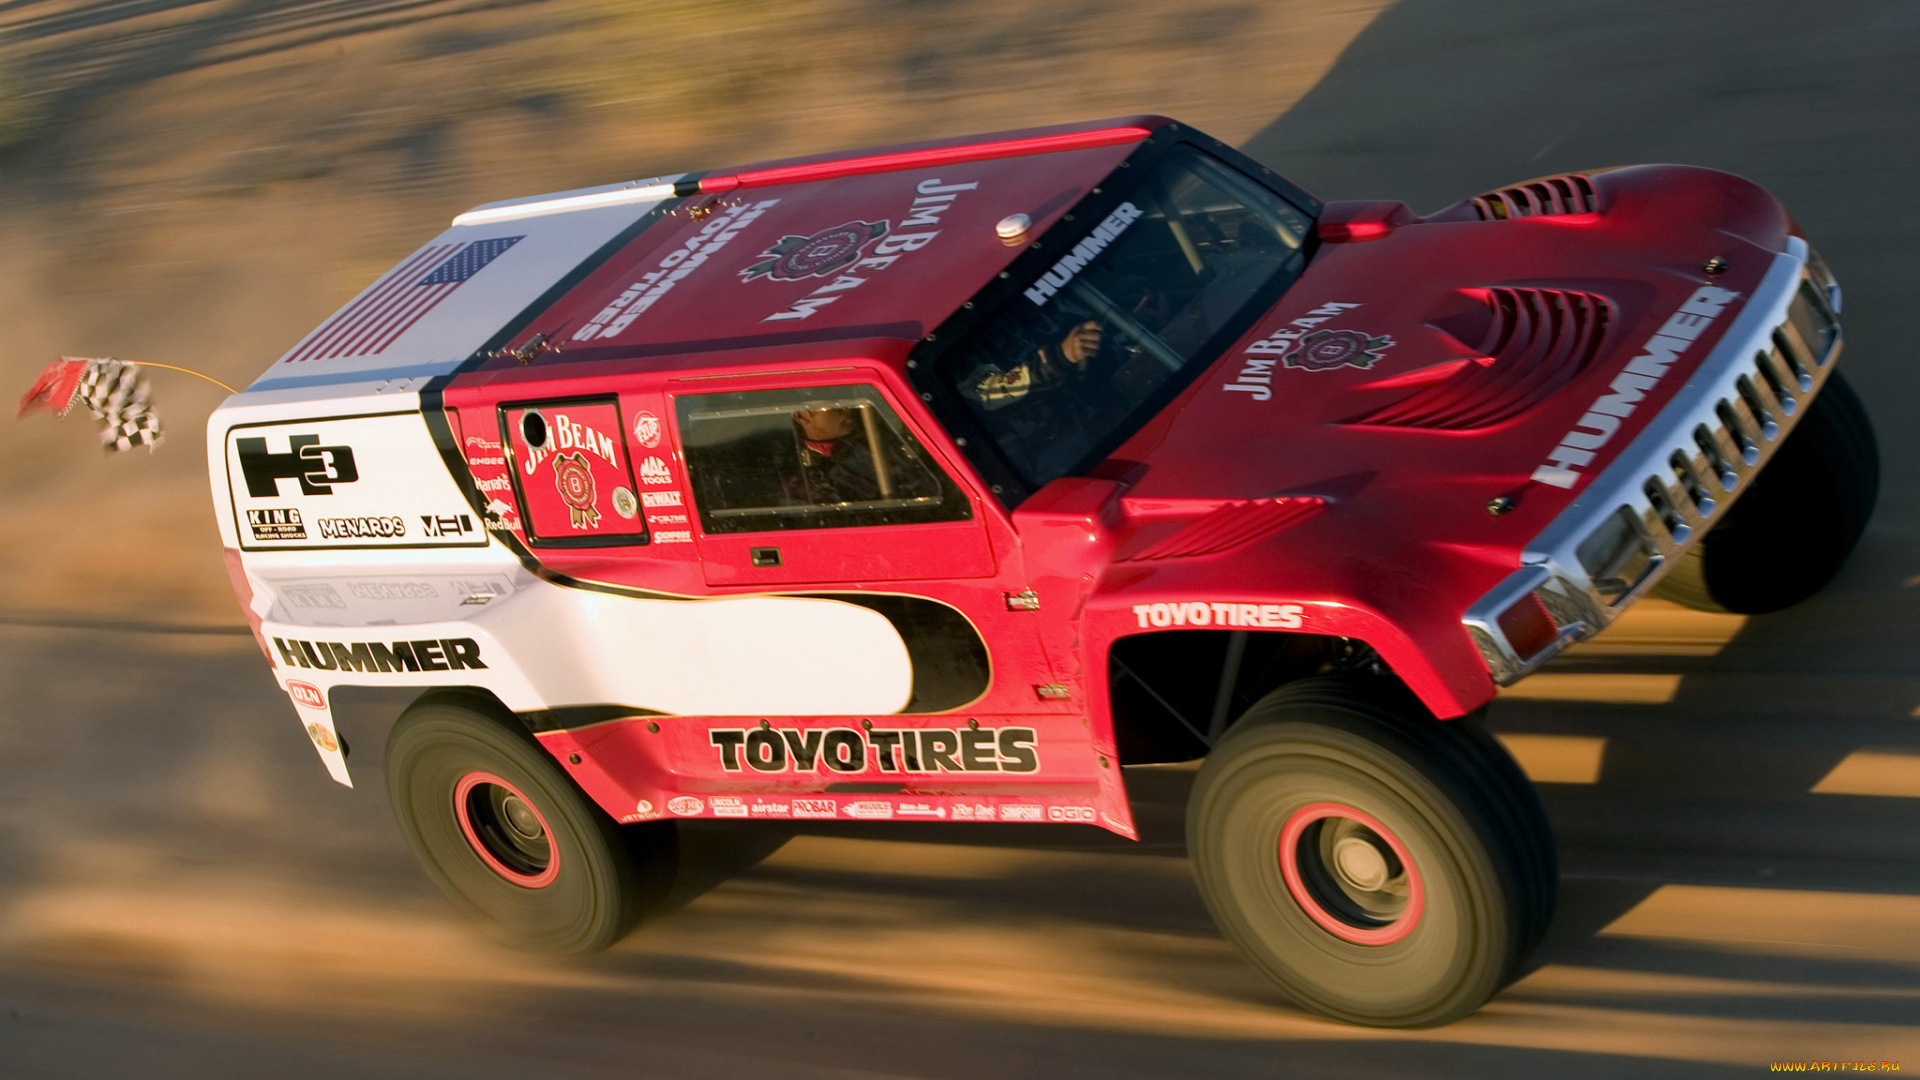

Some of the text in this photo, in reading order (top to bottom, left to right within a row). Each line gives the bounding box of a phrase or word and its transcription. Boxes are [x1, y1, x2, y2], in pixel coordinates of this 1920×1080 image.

[898, 178, 980, 228] JIM
[658, 202, 752, 270] TOYO
[1023, 201, 1144, 307] HUMMER
[594, 199, 781, 341] HUMMER
[760, 228, 943, 324] BEAM
[571, 270, 672, 342] TIRES
[1245, 300, 1366, 356] BEAM
[1222, 358, 1279, 401] JIM
[1530, 285, 1742, 490] HUMMER
[236, 433, 359, 498] H3
[554, 413, 620, 471] BEAM
[640, 455, 671, 477] MAC
[641, 476, 673, 485] TOOLS
[248, 509, 301, 524] KING
[318, 515, 406, 539] MENARDS
[484, 516, 522, 531] Red Bull
[1132, 602, 1303, 628] TOYO TIRES
[272, 636, 489, 673] HUMMER
[708, 726, 1042, 775] TOYO TIRES
[1047, 806, 1097, 822] OGIO
